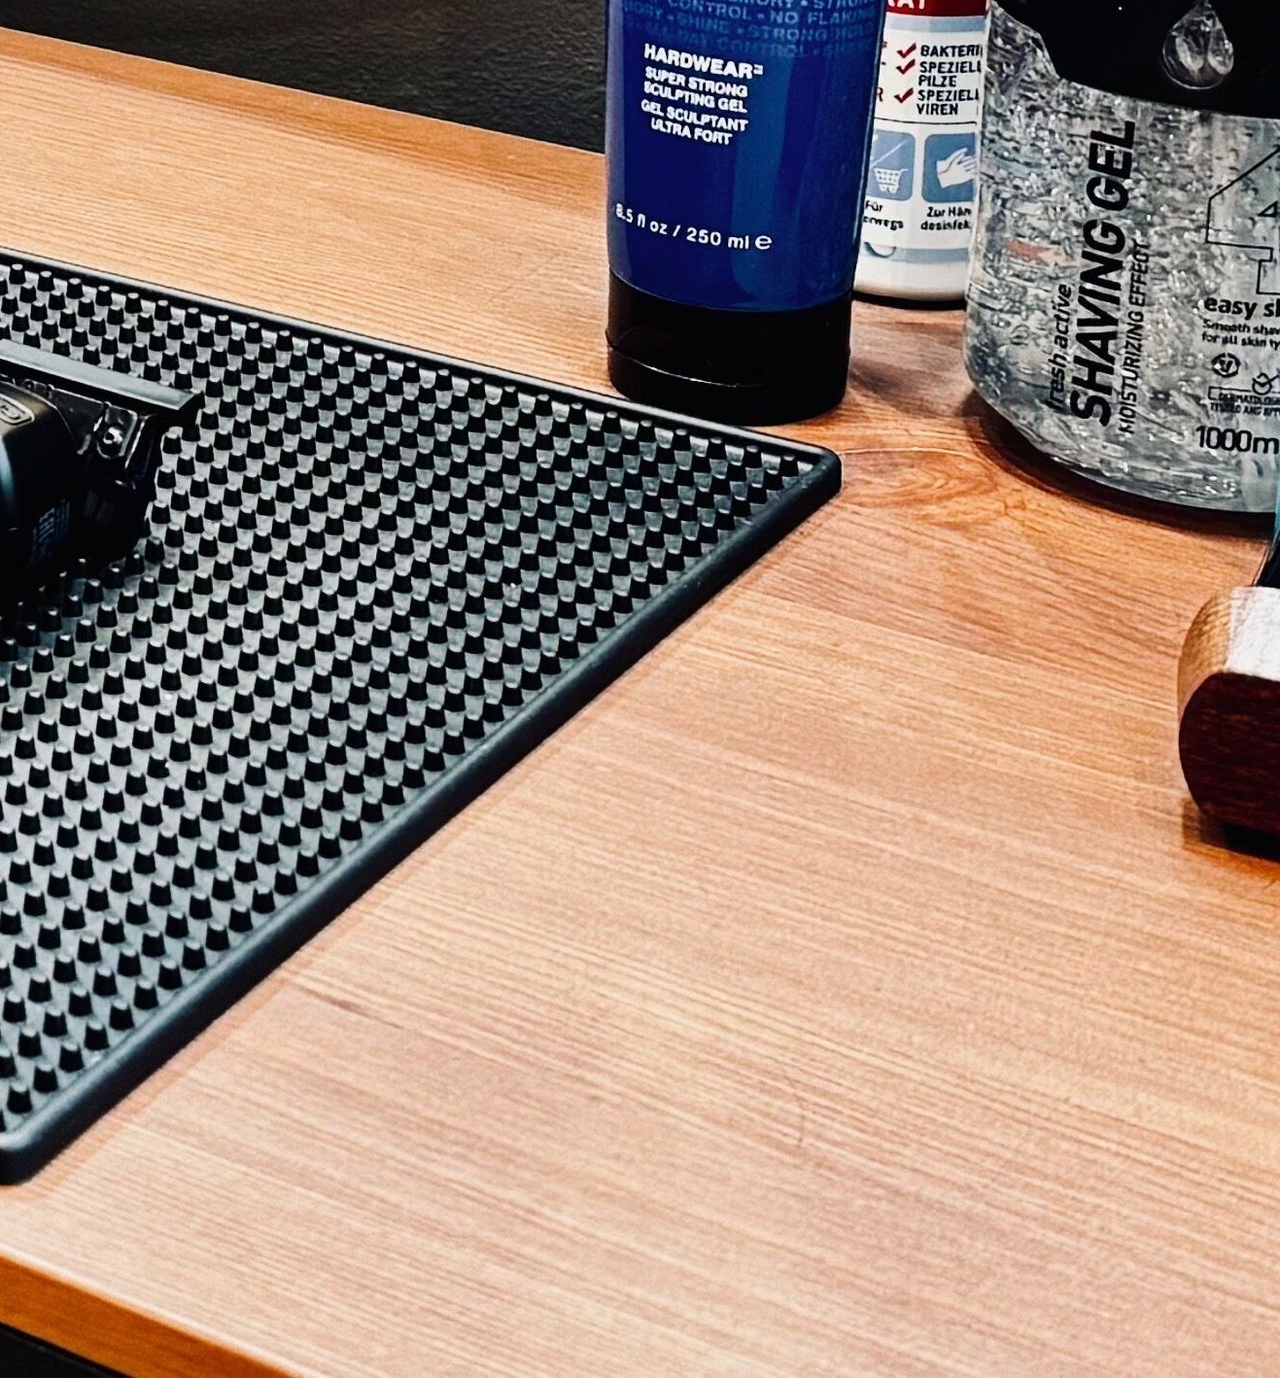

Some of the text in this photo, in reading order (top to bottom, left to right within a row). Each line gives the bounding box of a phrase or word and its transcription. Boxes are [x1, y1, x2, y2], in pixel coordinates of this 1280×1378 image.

[770, 10, 799, 24] NO
[645, 66, 749, 98] SUPER STRONG
[918, 74, 957, 88] PILZE
[643, 81, 748, 113] SCULPTING GEL
[916, 102, 959, 116] VIREN
[640, 99, 749, 132] GEL SCULPTANT
[651, 117, 734, 146] ULTRA FORT
[650, 219, 668, 235] oz
[686, 227, 722, 246] 250
[728, 235, 750, 250] ml
[1069, 120, 1136, 427] SHAVING GEL
[1051, 283, 1072, 350] active
[1204, 296, 1257, 321] easy
